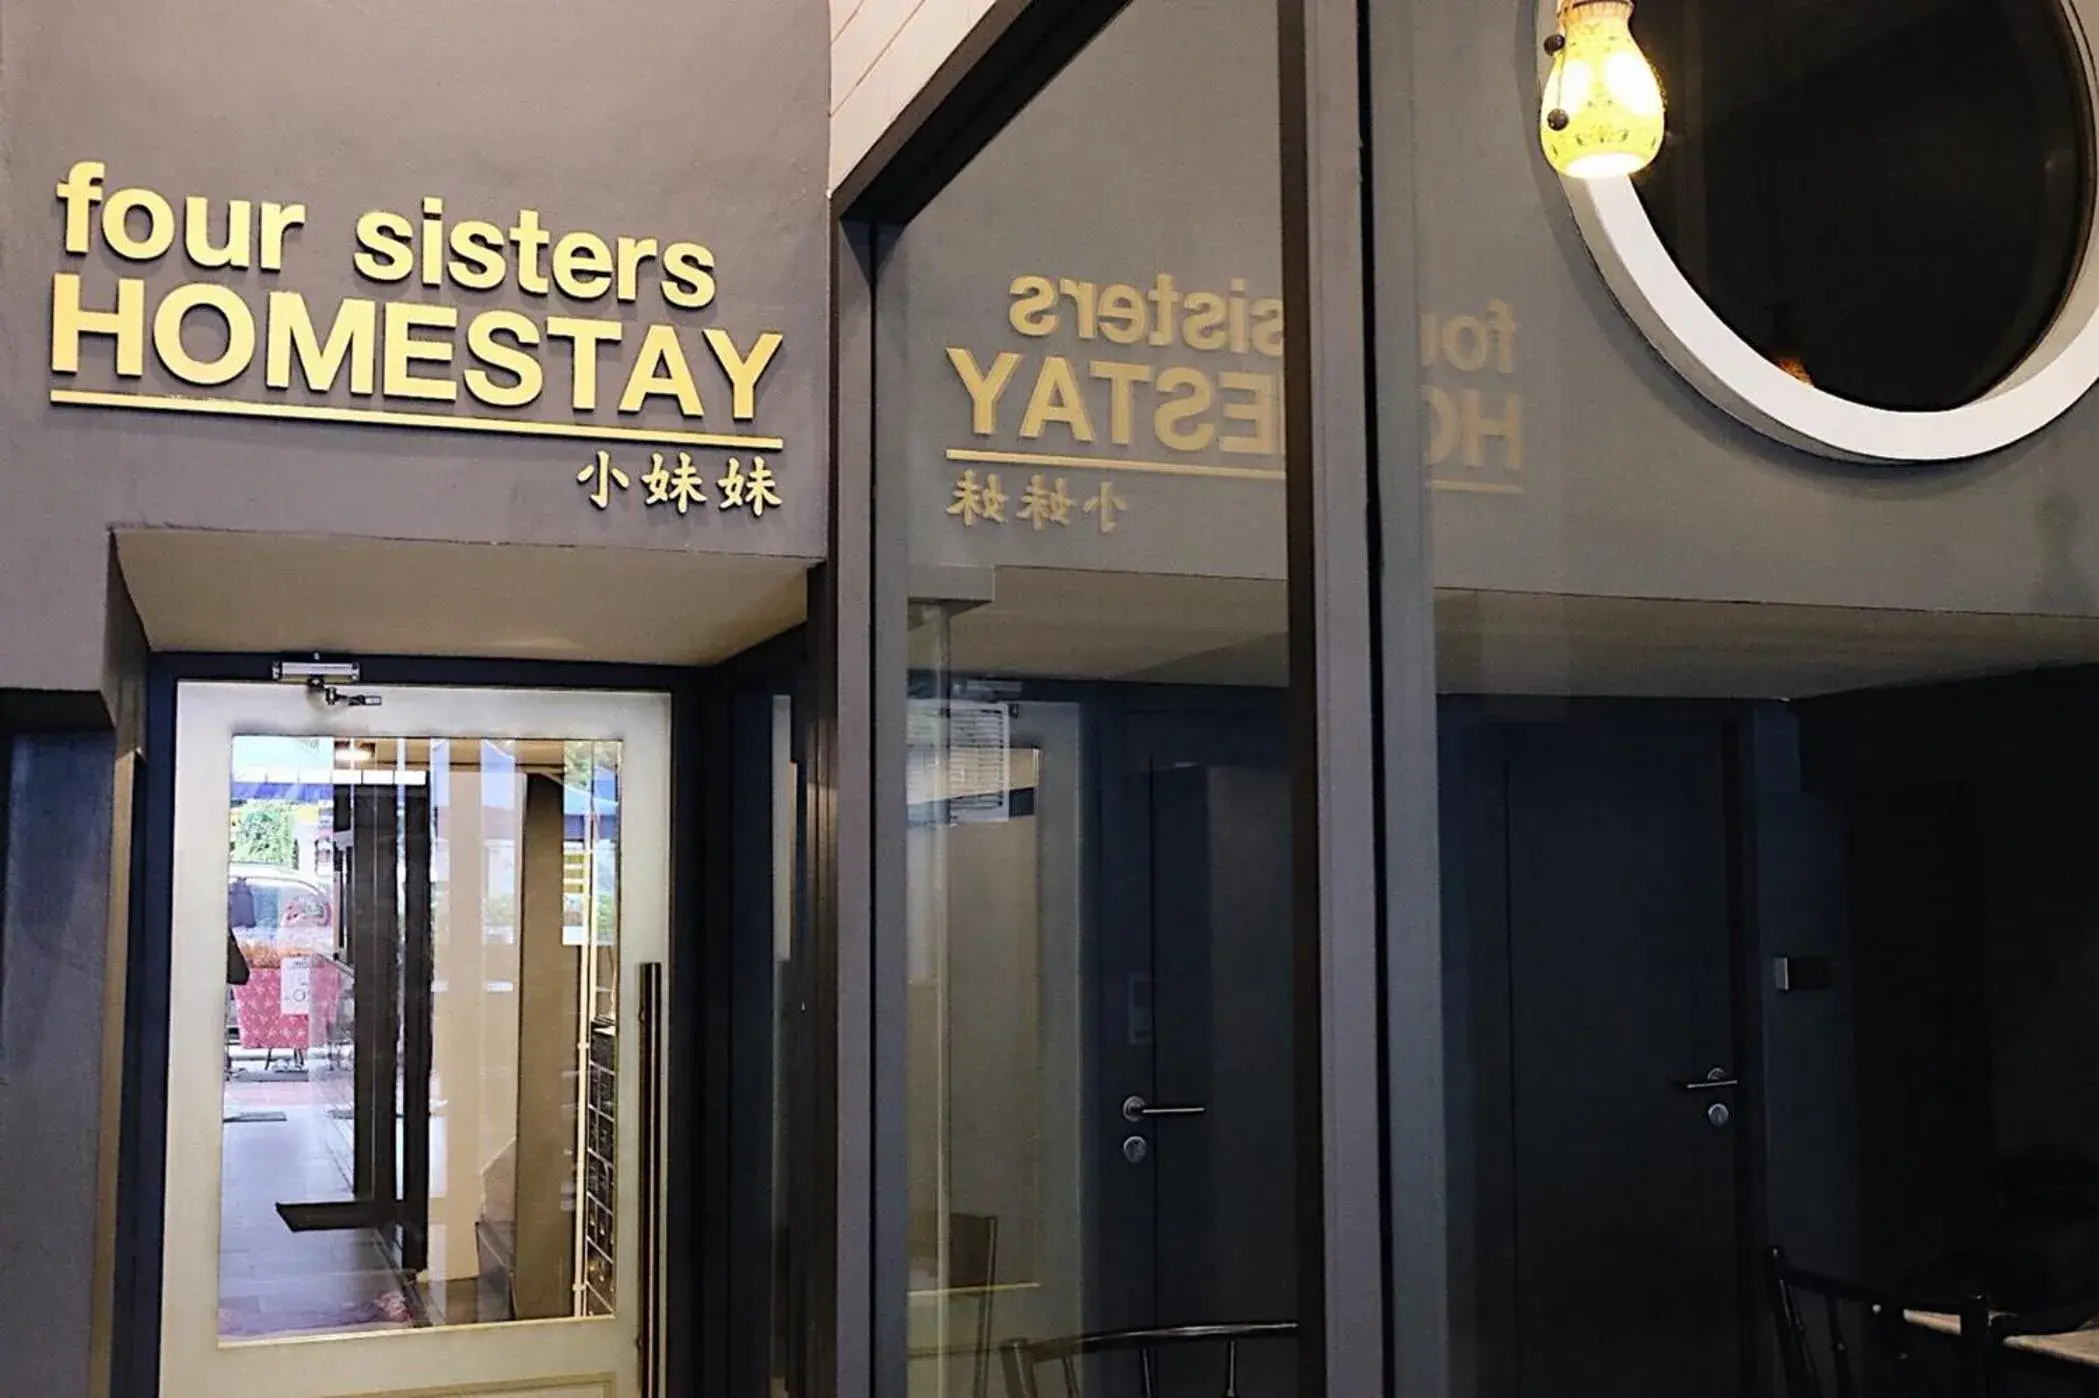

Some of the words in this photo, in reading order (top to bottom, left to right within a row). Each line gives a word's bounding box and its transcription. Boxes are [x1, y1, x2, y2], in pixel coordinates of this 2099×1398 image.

[56, 160, 306, 272] four
[354, 197, 717, 308] sisters
[51, 271, 784, 421] HOMESTAY
[576, 450, 784, 518] 小妹妹
